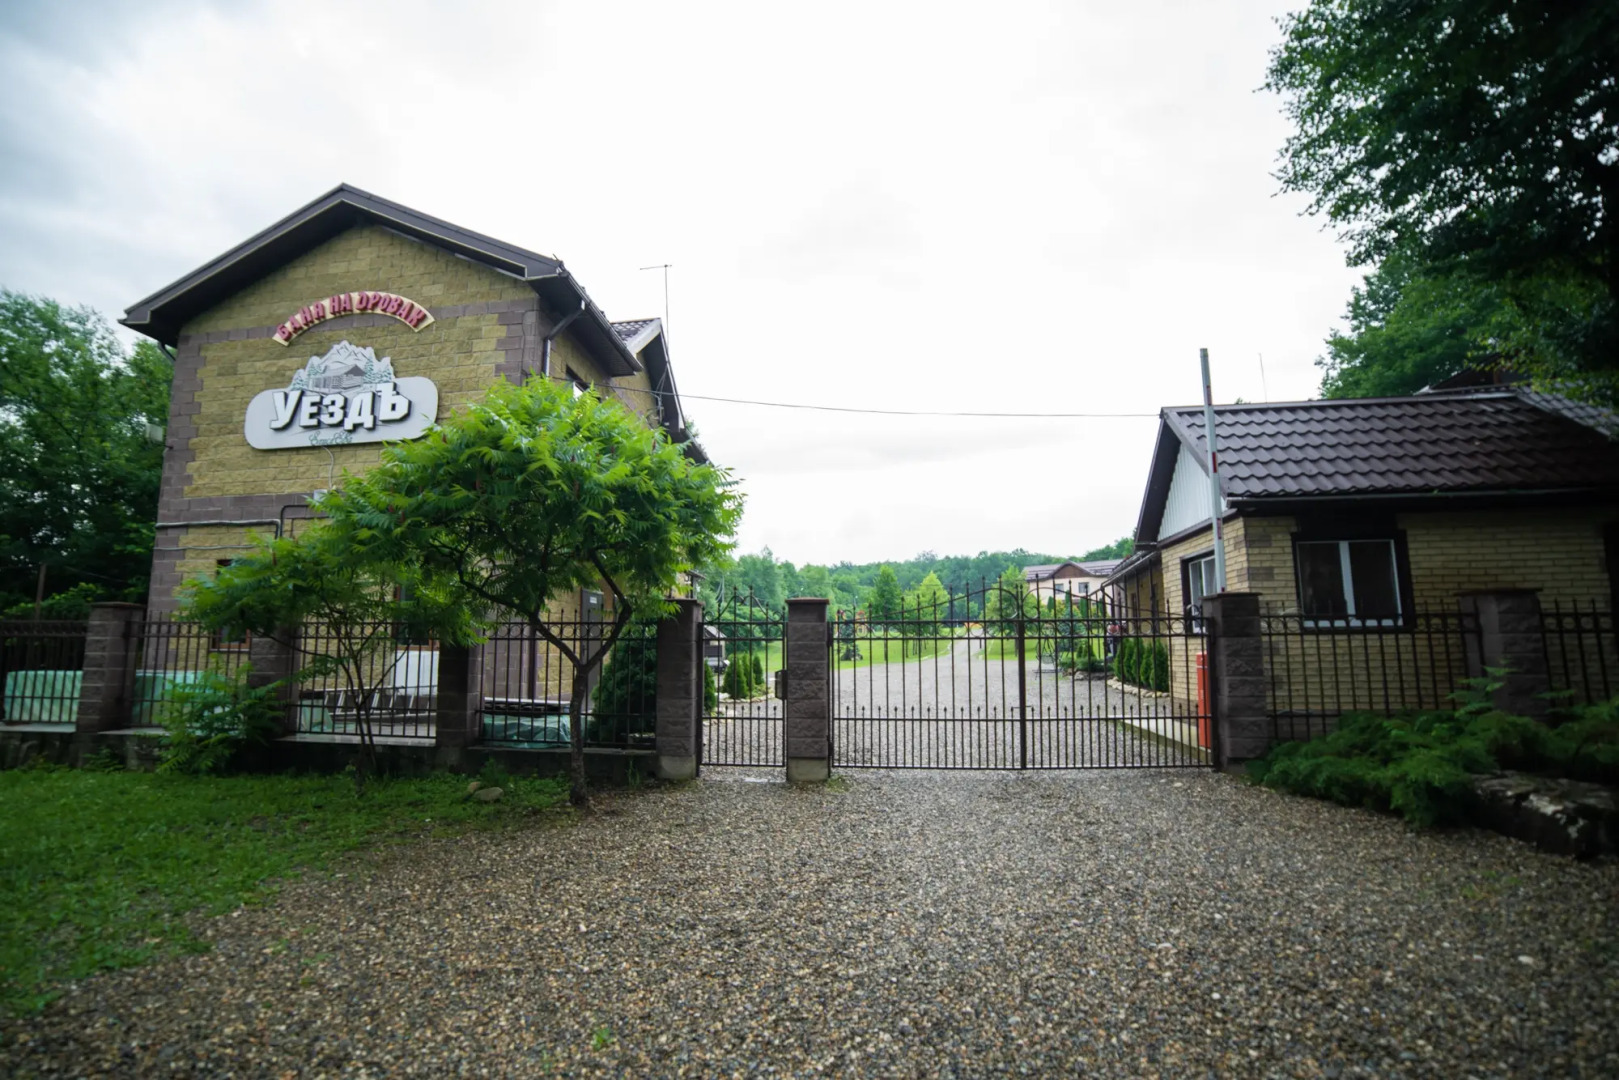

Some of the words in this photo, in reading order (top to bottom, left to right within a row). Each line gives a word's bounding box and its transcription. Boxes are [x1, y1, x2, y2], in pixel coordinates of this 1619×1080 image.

[276, 301, 326, 342] БАНЯ
[329, 292, 353, 315] НА
[355, 291, 427, 328] ДРОВАХ
